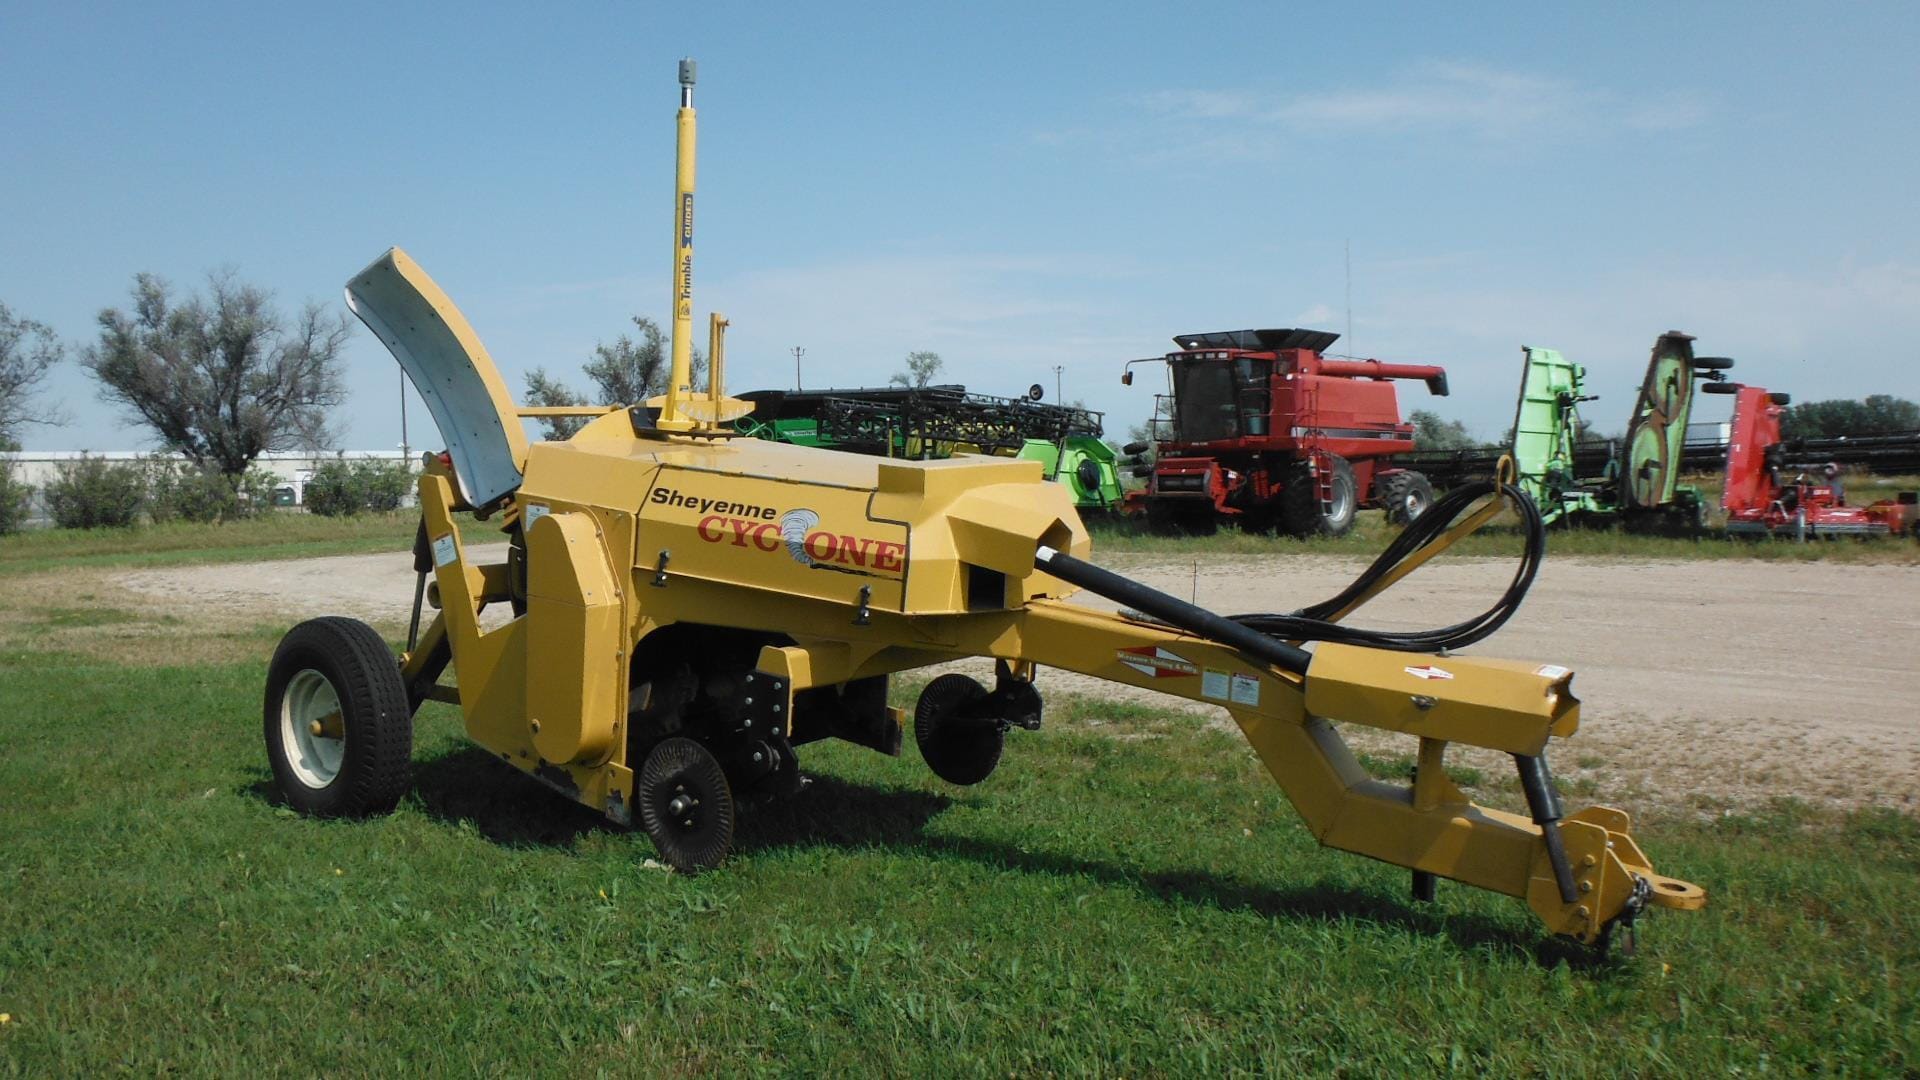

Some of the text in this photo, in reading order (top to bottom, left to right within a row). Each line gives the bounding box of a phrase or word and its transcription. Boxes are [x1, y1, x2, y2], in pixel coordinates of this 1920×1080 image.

[680, 197, 692, 301] Trimble GUIDED
[651, 487, 777, 520] Sheyenne
